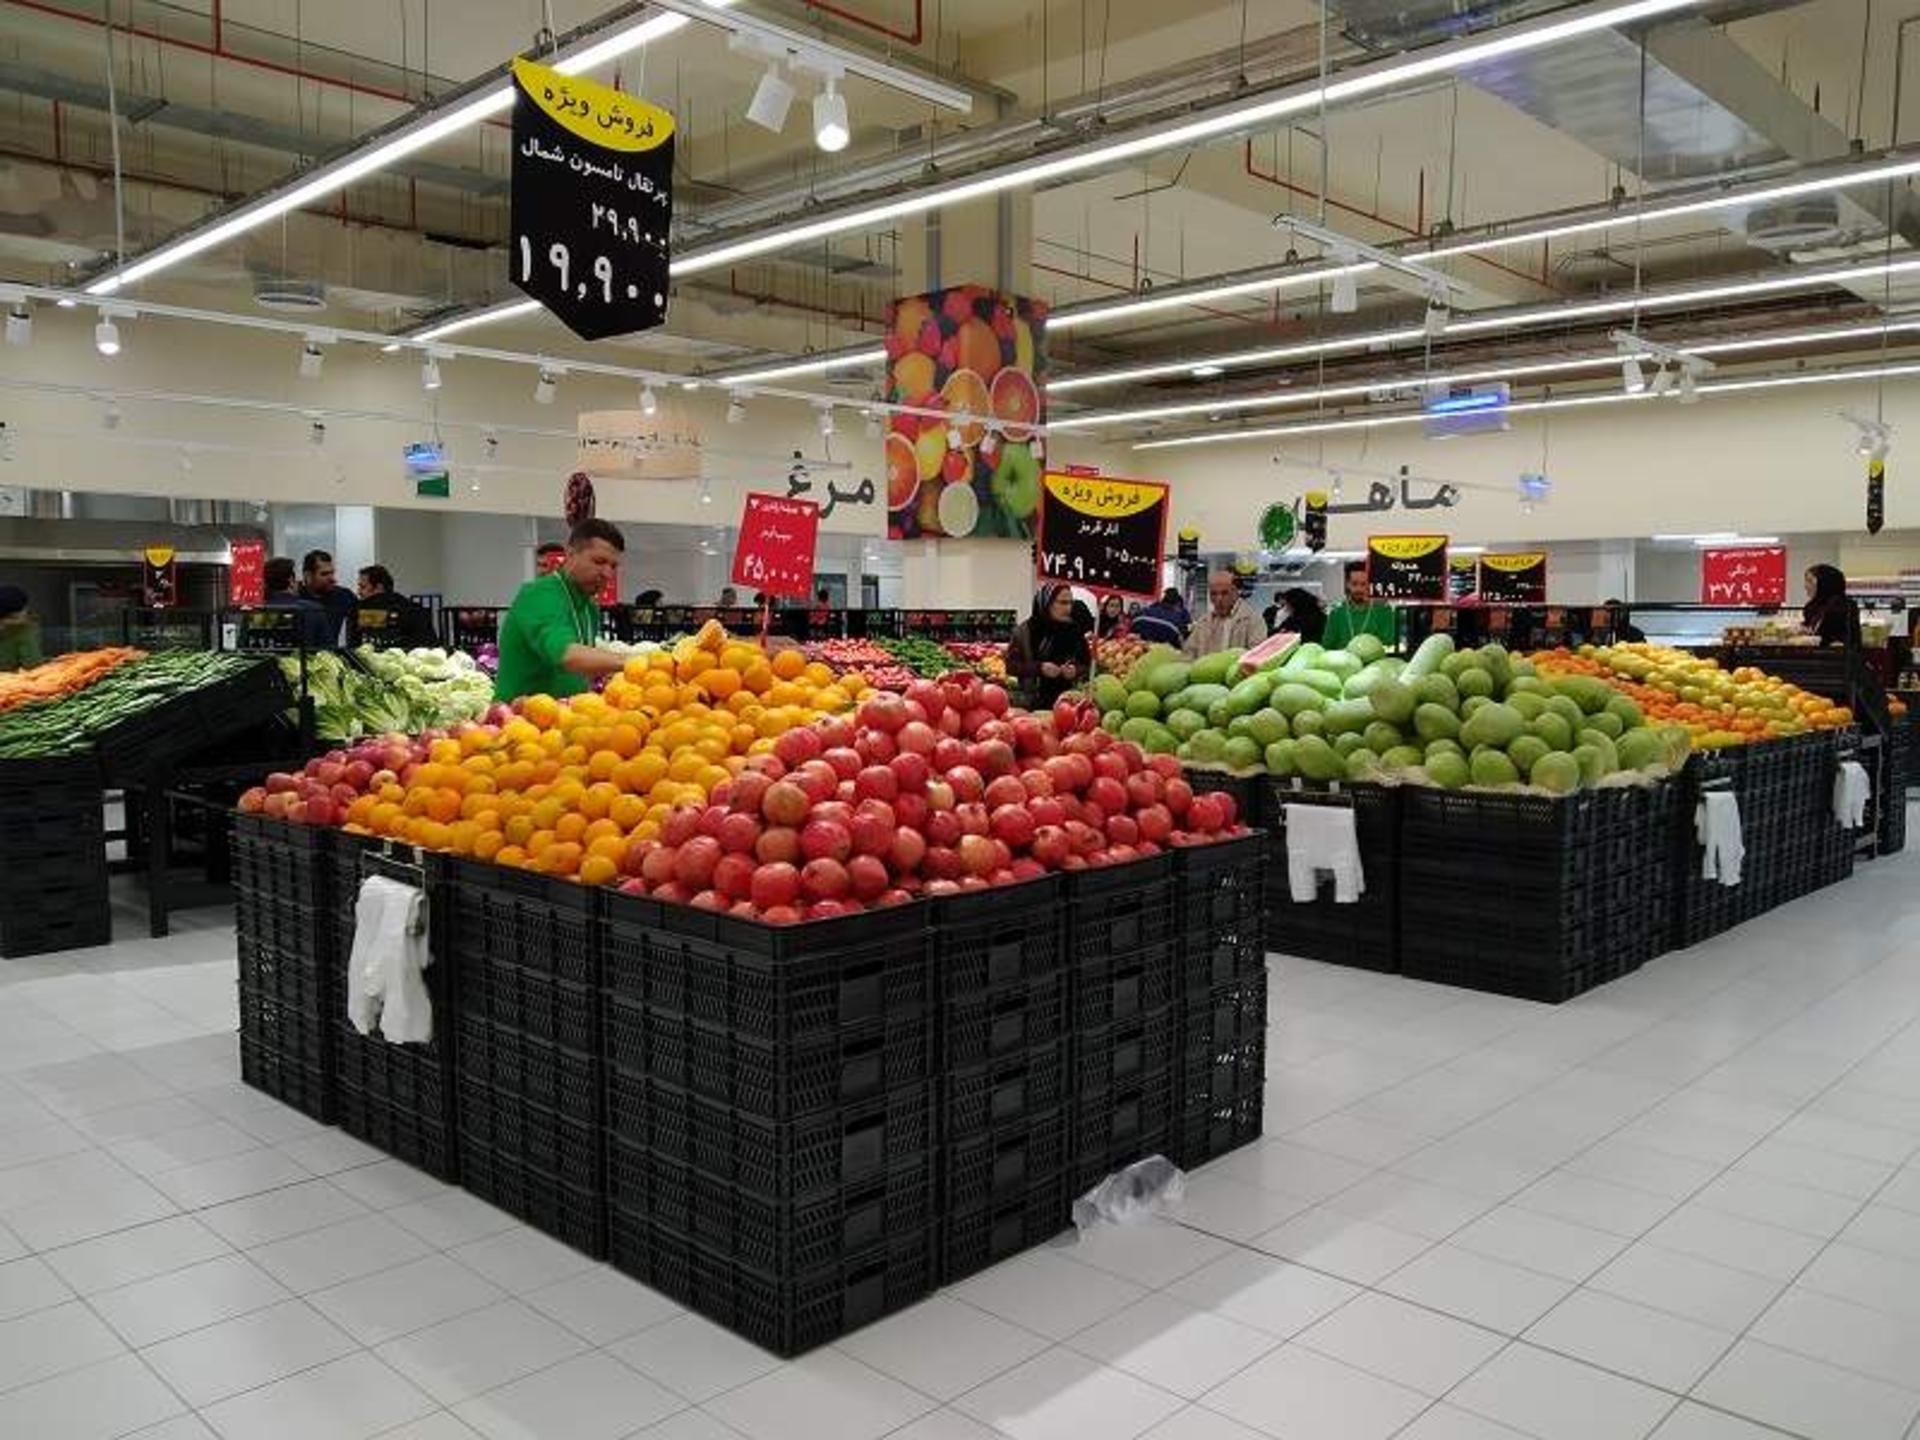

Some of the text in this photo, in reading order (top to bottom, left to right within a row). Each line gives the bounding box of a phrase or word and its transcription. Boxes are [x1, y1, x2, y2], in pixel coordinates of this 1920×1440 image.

[543, 86, 655, 138] فروش ویژه
[520, 136, 566, 162] شمال
[569, 153, 624, 181] تامسون
[786, 450, 874, 520] مرغ
[1063, 482, 1141, 509] فروش ویژه
